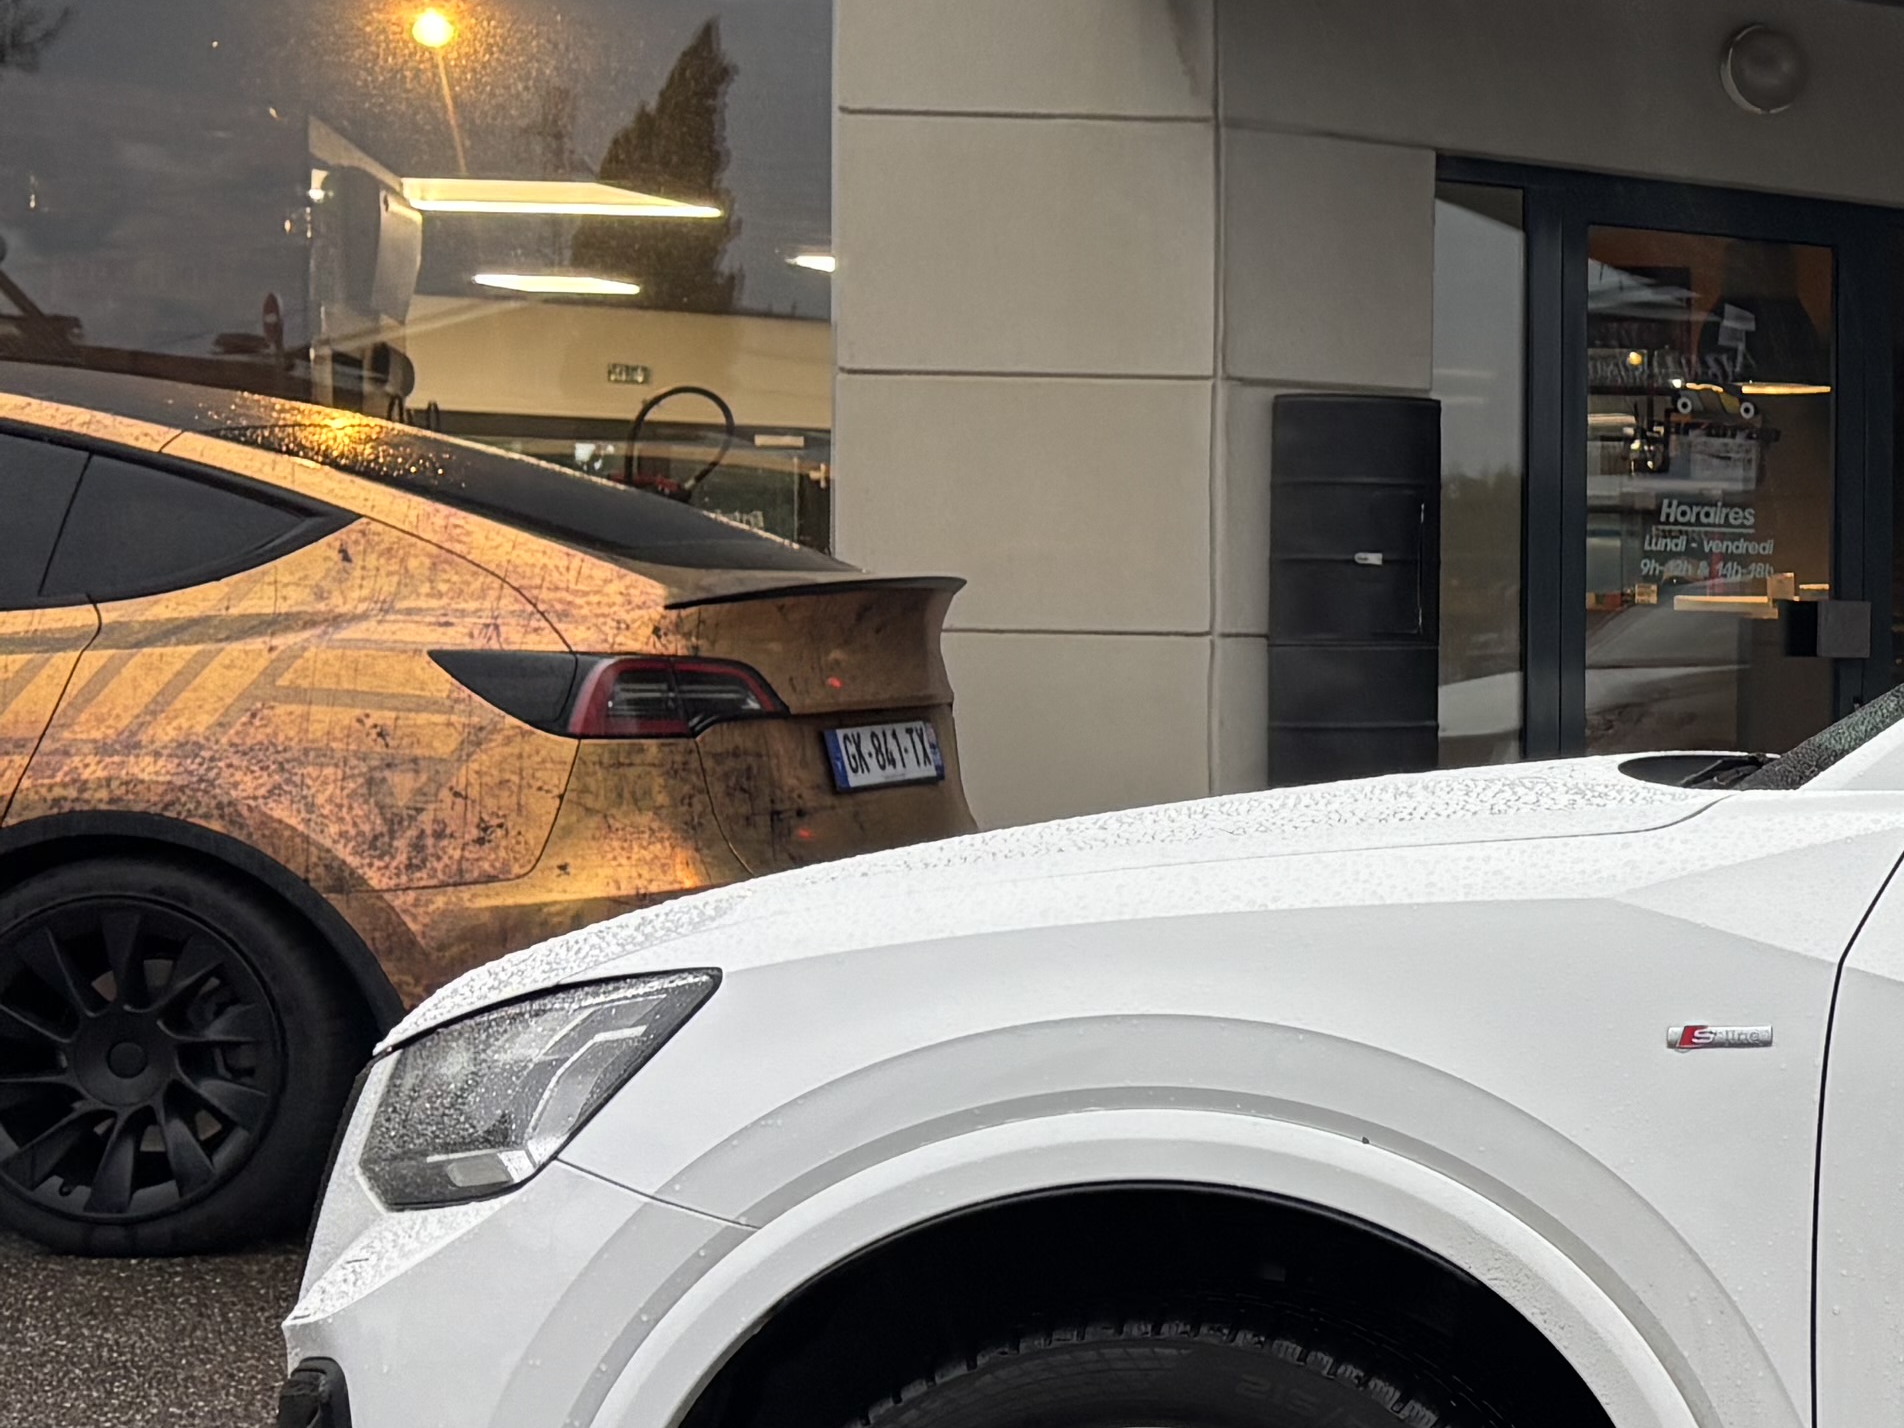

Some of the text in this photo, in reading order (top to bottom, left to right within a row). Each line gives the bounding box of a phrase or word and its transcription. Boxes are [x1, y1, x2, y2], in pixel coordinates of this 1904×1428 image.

[1660, 498, 1756, 526] Horaires
[1643, 533, 1688, 552] Lundi
[1703, 537, 1775, 555] vendredi
[842, 727, 932, 775] GK-841-TX
